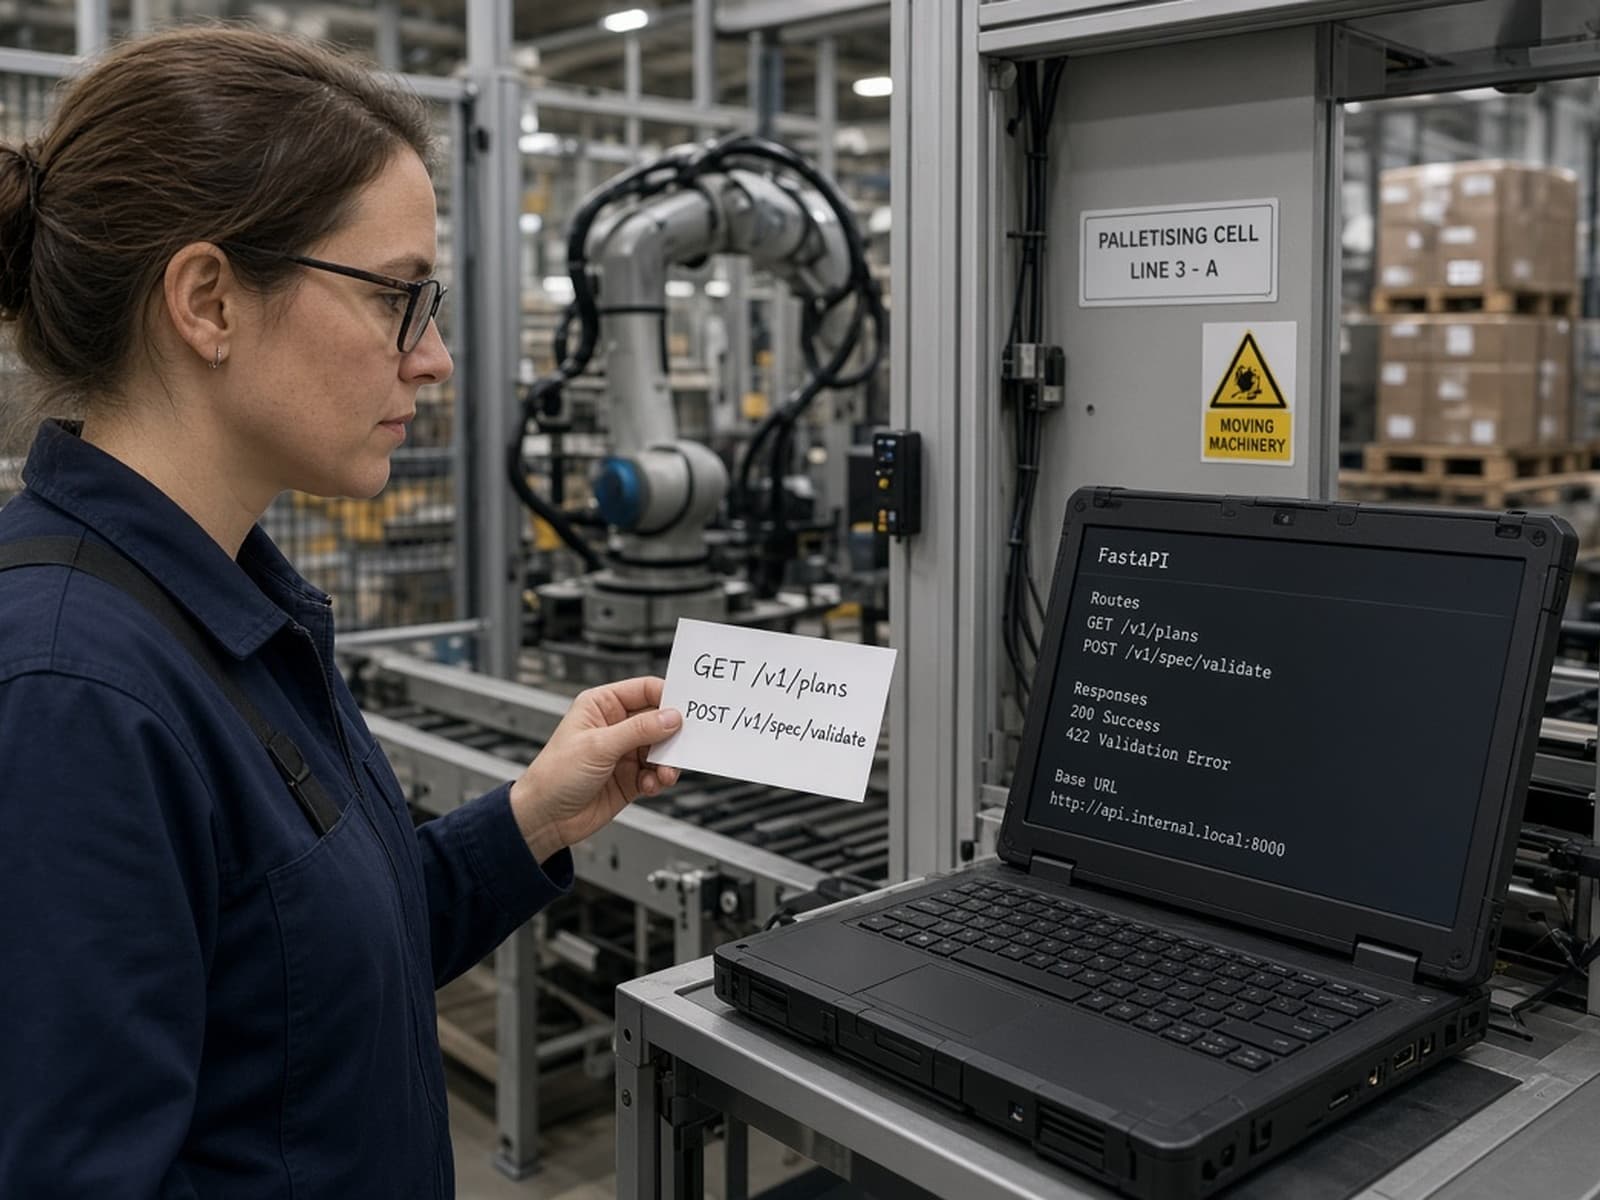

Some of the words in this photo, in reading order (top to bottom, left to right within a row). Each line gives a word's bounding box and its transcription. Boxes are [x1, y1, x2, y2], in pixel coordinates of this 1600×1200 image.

[1098, 226, 1207, 248] PALLETISING
[1213, 224, 1258, 243] CELL
[1130, 260, 1168, 279] LINE
[1175, 260, 1185, 277] 3
[1205, 258, 1218, 277] A
[1220, 417, 1273, 433] MOVING
[1209, 435, 1285, 452] MACHINERY
[1097, 547, 1169, 568] FastAPI
[1090, 591, 1139, 608] Routes
[1086, 615, 1113, 630] GET
[1120, 618, 1199, 642] /v1/plans
[1082, 638, 1117, 655] POST
[1124, 644, 1272, 679] /v1/spec/validate
[693, 653, 745, 680] GET
[750, 662, 847, 699] /v1/plans
[1073, 681, 1147, 706] Responses
[686, 700, 729, 723] POST
[731, 707, 865, 747] /v1/spec/validate
[1069, 704, 1094, 720] 200
[1102, 710, 1160, 732] Success
[1065, 727, 1089, 743] 422
[1098, 732, 1178, 761] Validation
[1186, 750, 1231, 771] Error
[1054, 768, 1085, 787] Base
[1093, 776, 1117, 794] URL
[1049, 790, 1285, 857] http://api.internal.local:8000
